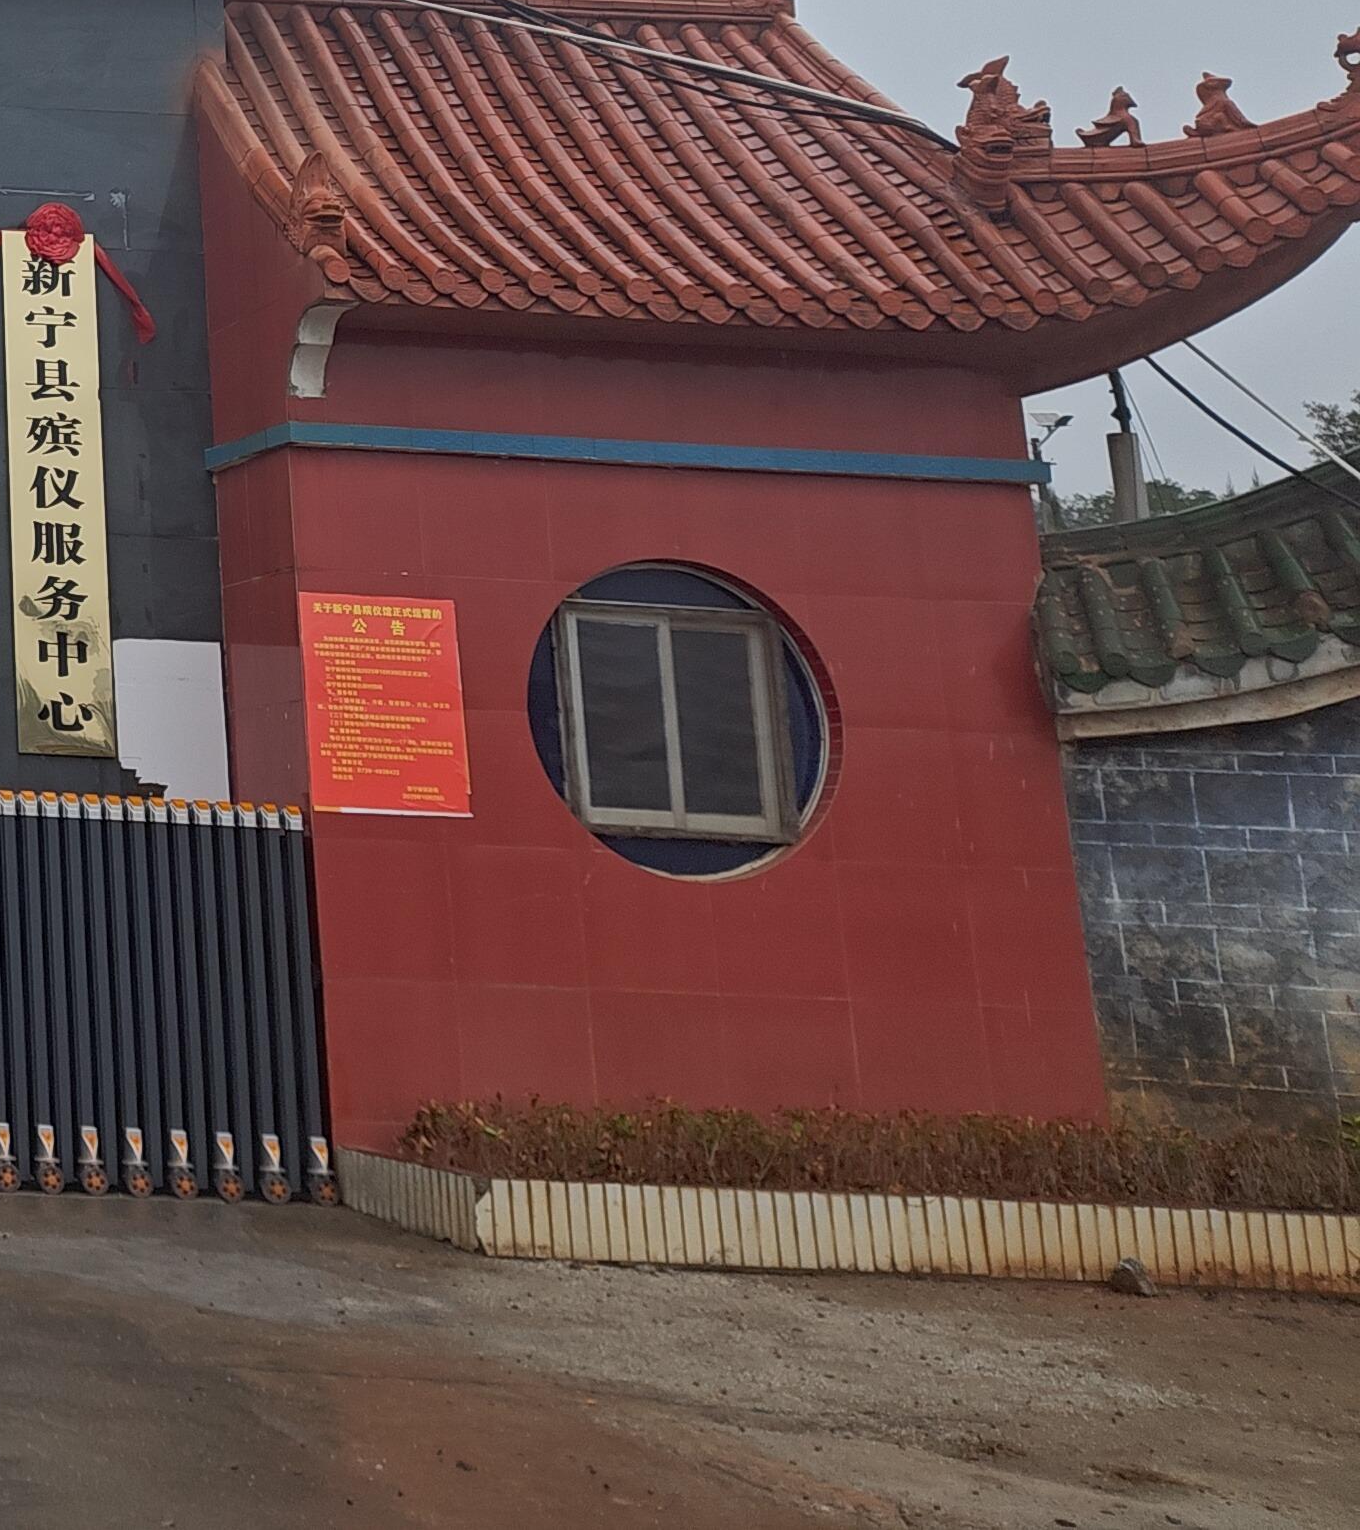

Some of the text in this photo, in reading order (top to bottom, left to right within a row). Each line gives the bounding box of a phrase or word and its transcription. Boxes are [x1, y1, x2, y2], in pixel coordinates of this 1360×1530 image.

[21, 254, 94, 733] 新宁县殡仪服务中心
[352, 618, 406, 637] 公告
